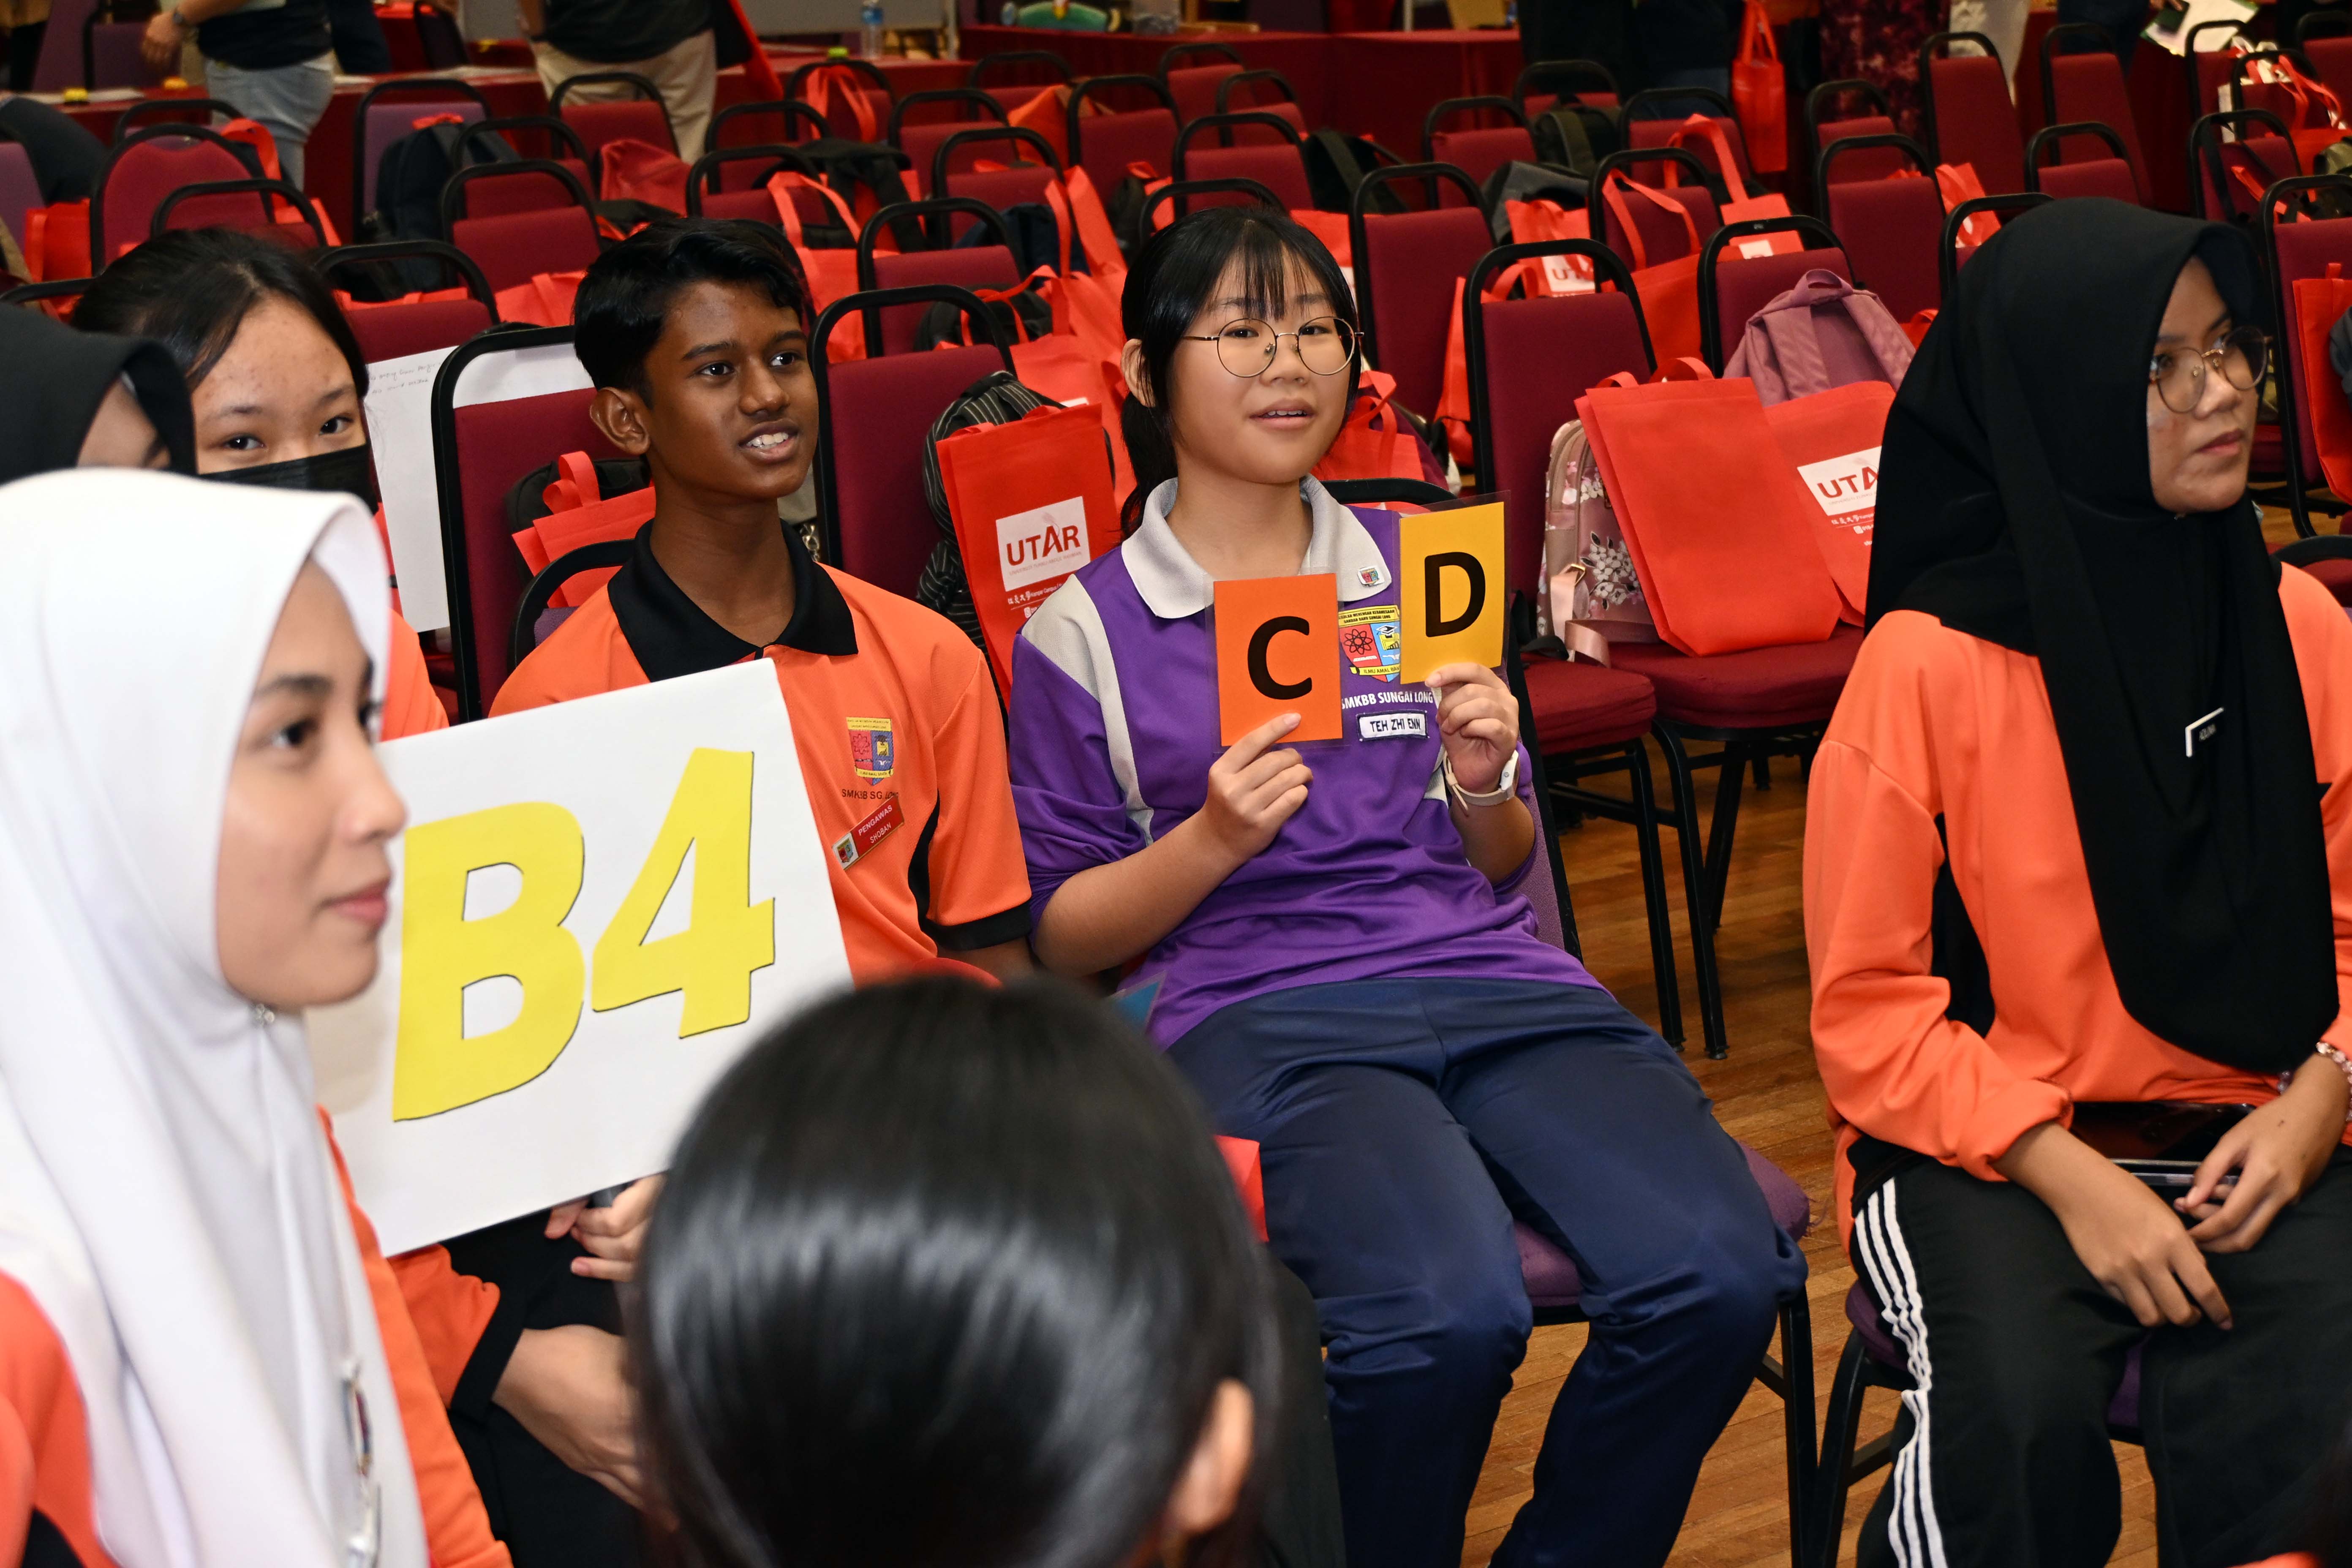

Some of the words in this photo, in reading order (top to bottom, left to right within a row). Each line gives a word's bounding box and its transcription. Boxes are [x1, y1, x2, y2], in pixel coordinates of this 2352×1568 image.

[1817, 466, 1878, 498] UTA
[1007, 525, 1080, 566] UTAR
[1425, 552, 1486, 637] D
[1248, 616, 1312, 700] C
[1377, 691, 1413, 703] SUNGAI
[1415, 691, 1433, 703] LONG
[1370, 720, 1388, 732] TEH
[1391, 719, 1405, 730] ZHI
[1407, 718, 1421, 730] ENN
[858, 805, 892, 836] PENGAWAS
[870, 822, 891, 843] SHOBAN
[392, 747, 775, 1122] B4
